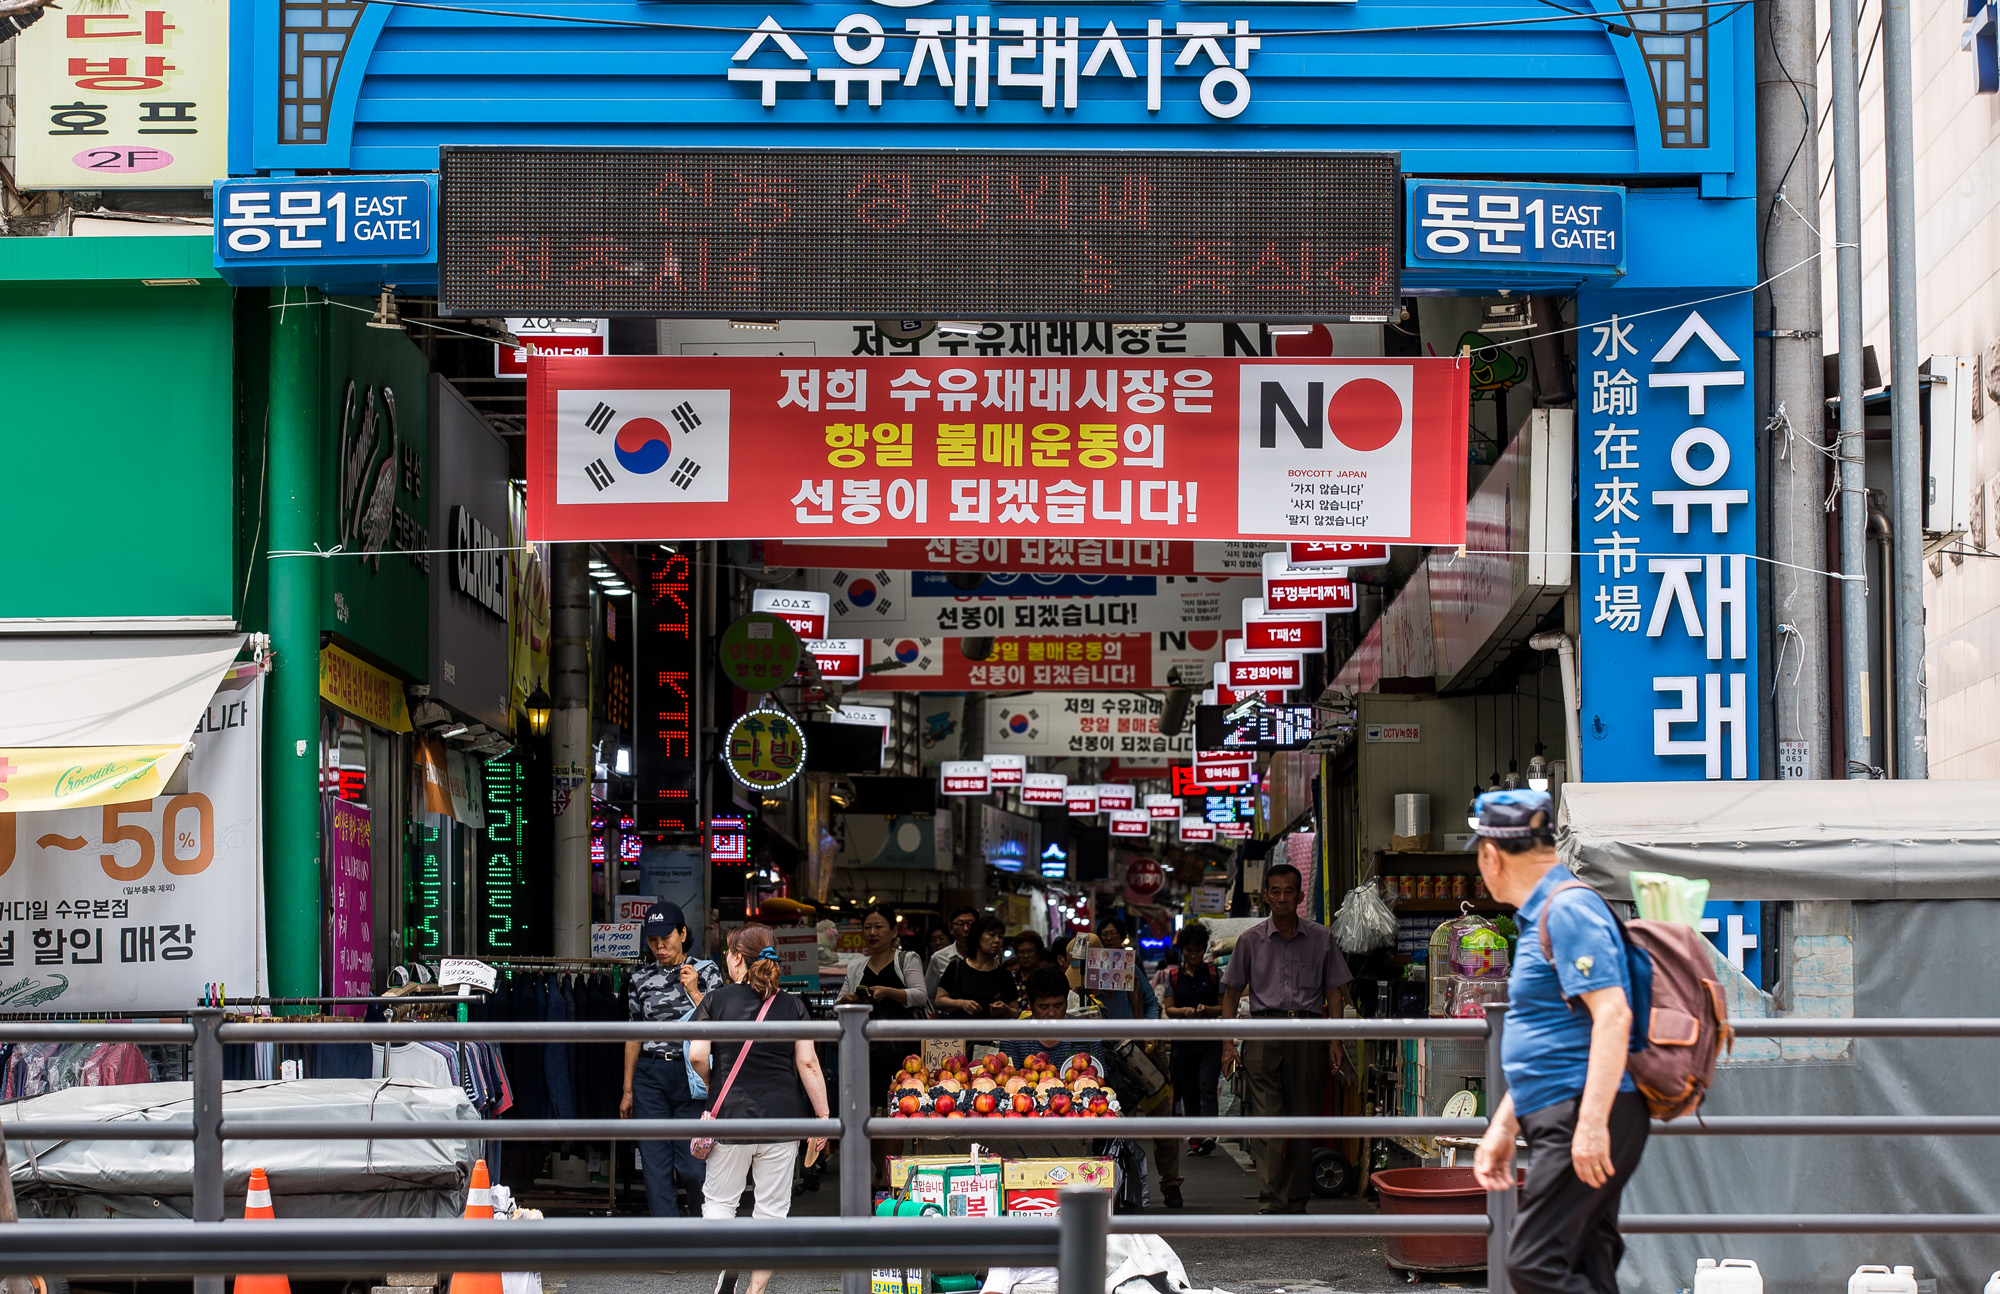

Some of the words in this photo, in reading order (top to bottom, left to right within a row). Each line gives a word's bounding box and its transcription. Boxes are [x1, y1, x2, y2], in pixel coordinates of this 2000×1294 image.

[728, 14, 1261, 119] 수유재래시장
[48, 101, 198, 136] 호프
[88, 151, 158, 168] 2F
[355, 196, 407, 217] EAST
[1552, 205, 1602, 227] EAST
[223, 191, 346, 253] 동문1
[354, 220, 421, 241] GATE1
[1422, 194, 1544, 254] 동문1
[1551, 228, 1615, 250] GATE1
[777, 368, 867, 411] 저희
[890, 368, 1213, 412] 수유재래시장은
[825, 423, 913, 468] 항일
[936, 424, 1163, 468] 불매운동의
[1288, 469, 1333, 478] BOYCOTT
[1336, 470, 1367, 478] JAPAN
[1592, 313, 1642, 633] 水踰在來市場
[790, 478, 928, 525] 선봉이
[950, 478, 1198, 525] 되겠습니다!
[925, 538, 1002, 563] 선봉이
[1271, 585, 1350, 603] 뚜껑부대찌개
[787, 619, 812, 632] 대여
[937, 605, 1005, 630] 선봉이
[1015, 602, 1137, 628] 되겠습니다!
[1268, 628, 1301, 642] T패션
[1028, 641, 1122, 662] 불매운동의
[968, 665, 1026, 686] 선봉이
[1034, 664, 1136, 686] 되겠습니다!
[742, 718, 792, 737] 수유
[731, 739, 801, 769] 다방
[54, 760, 120, 799] Crocodile
[1787, 766, 1803, 777] 10
[55, 898, 129, 920] 수유본점
[620, 902, 652, 919] 5,00
[32, 926, 103, 966] 할인
[120, 923, 197, 964] 매장
[950, 1179, 998, 1192] 고맙습니다
